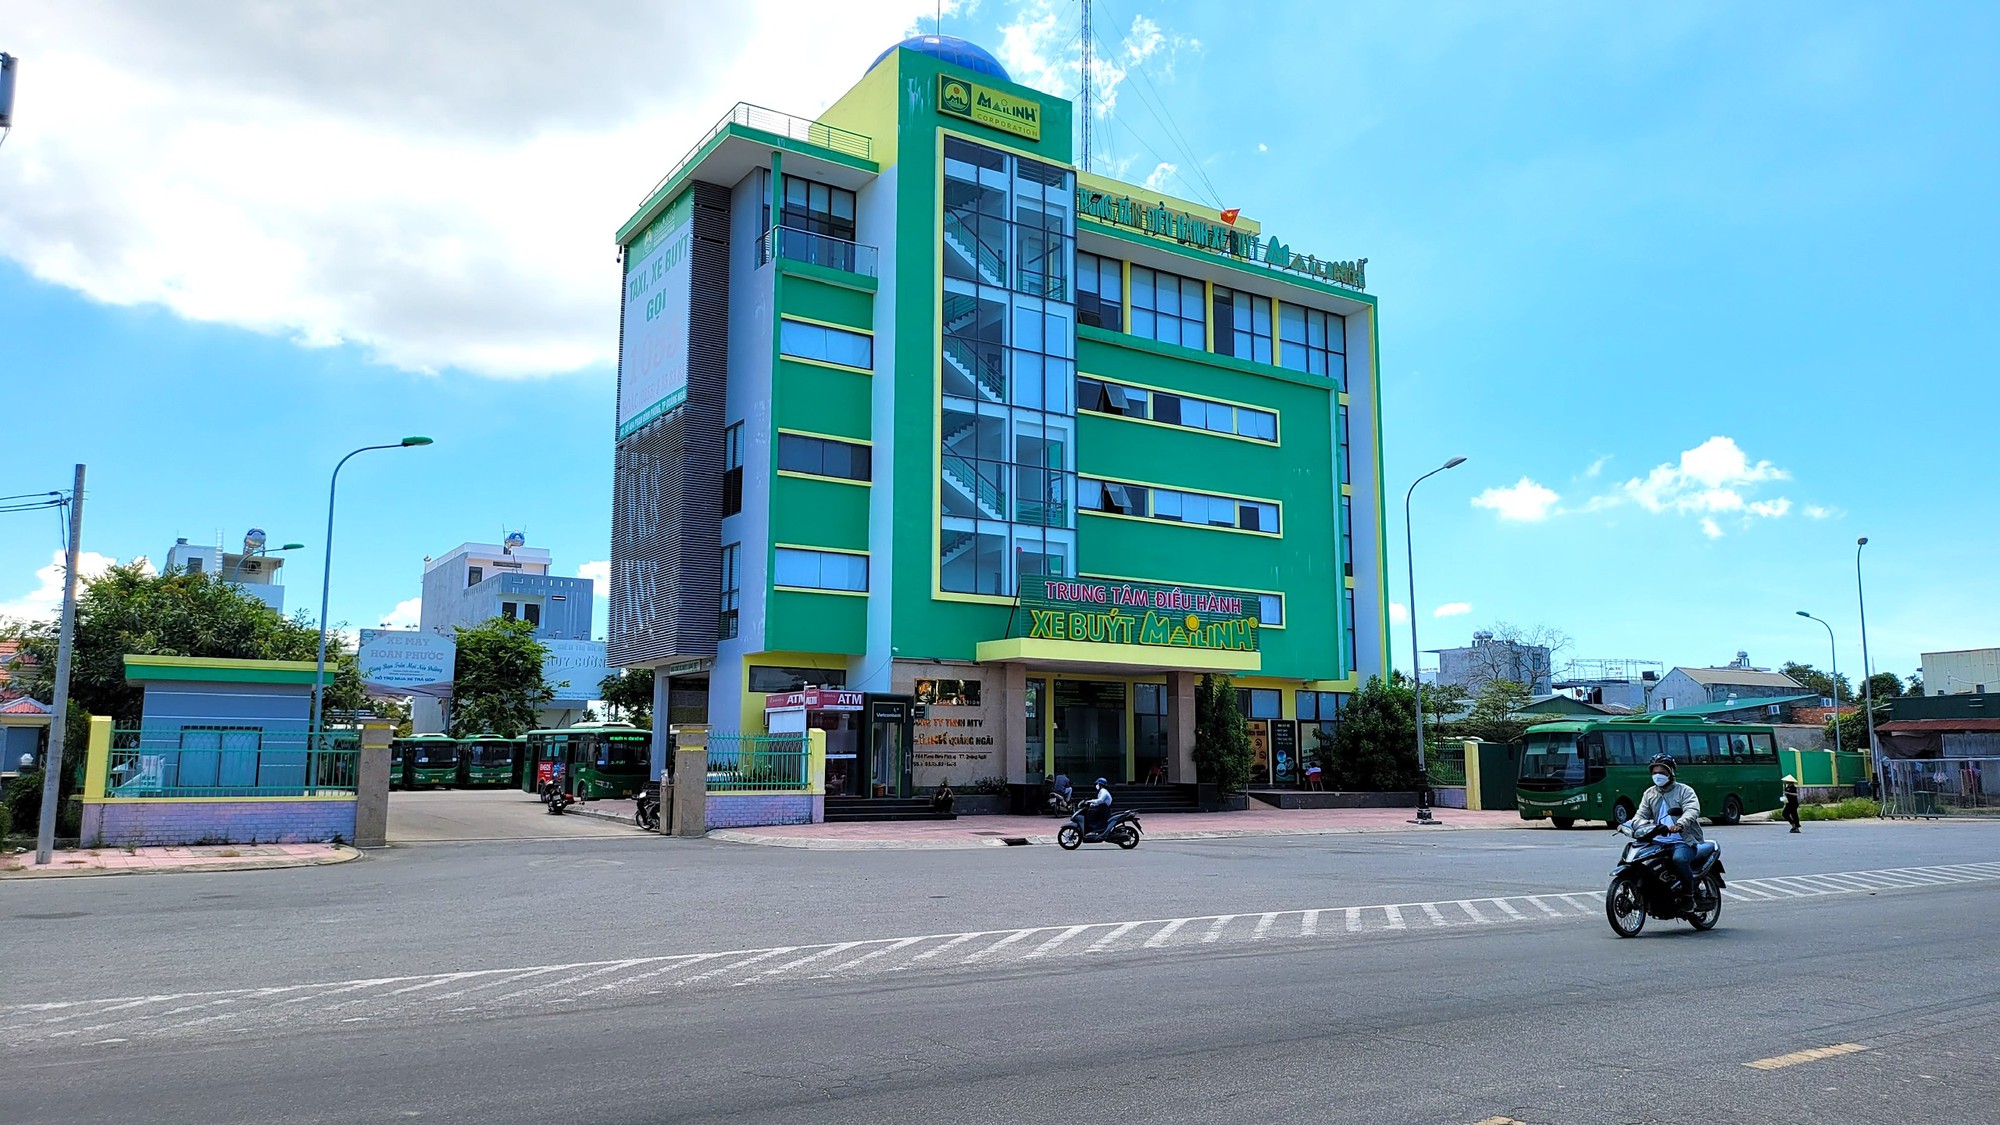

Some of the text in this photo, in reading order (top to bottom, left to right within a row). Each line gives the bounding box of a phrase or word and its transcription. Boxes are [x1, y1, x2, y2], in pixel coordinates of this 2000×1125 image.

[977, 114, 1038, 137] CORPORATION
[1116, 195, 1142, 229] TÂM
[1146, 201, 1173, 237] ĐIỀU
[1176, 212, 1209, 245] HÀNH
[1212, 225, 1227, 250] XE
[629, 232, 689, 303] TAXI, XE BUÝT
[646, 288, 667, 321] GỌI
[1046, 581, 1242, 615] TRUNG TÂM ĐIỀU HÀNH
[1030, 609, 1066, 640] XE
[1069, 608, 1136, 645] BUÝT
[387, 635, 430, 646] XE MÁY
[405, 648, 444, 661] PHƯỚC
[837, 693, 862, 705] ATM
[967, 719, 983, 727] MTV
[975, 734, 994, 746] NGÃI
